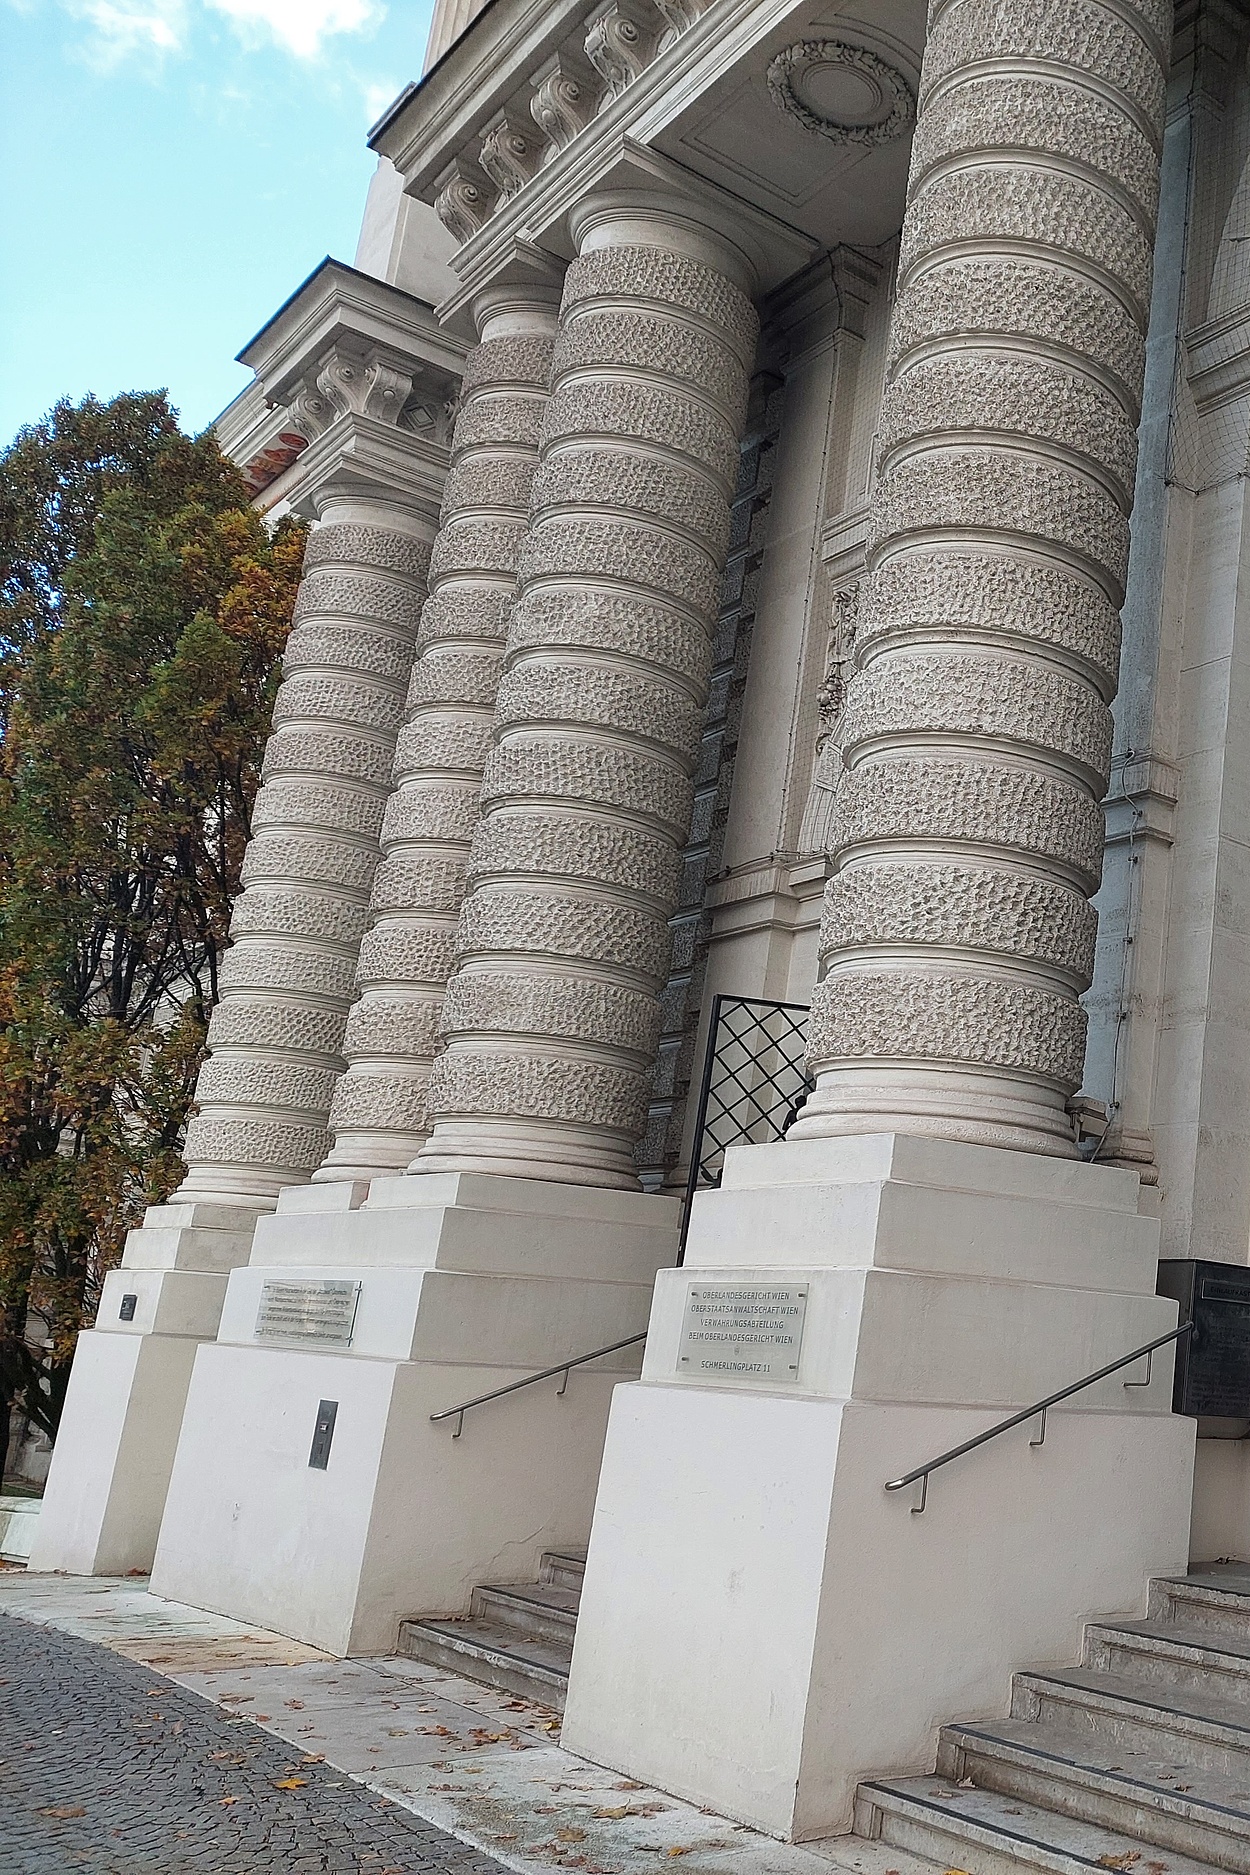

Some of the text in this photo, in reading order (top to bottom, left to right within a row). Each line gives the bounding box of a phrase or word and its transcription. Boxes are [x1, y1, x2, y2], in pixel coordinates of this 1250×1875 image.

[702, 1291, 790, 1300] OBERLANDESGERICHT WIEN
[691, 1305, 799, 1315] OBERSTAATSANWALTSCHAFT WIEN
[700, 1318, 784, 1329] VERWAHRUNGSABTEILUNG
[688, 1332, 793, 1344] BEIM OBERLANDESGERICHT WIEN
[700, 1360, 771, 1373] SCHMERLINGPLATZ 11
